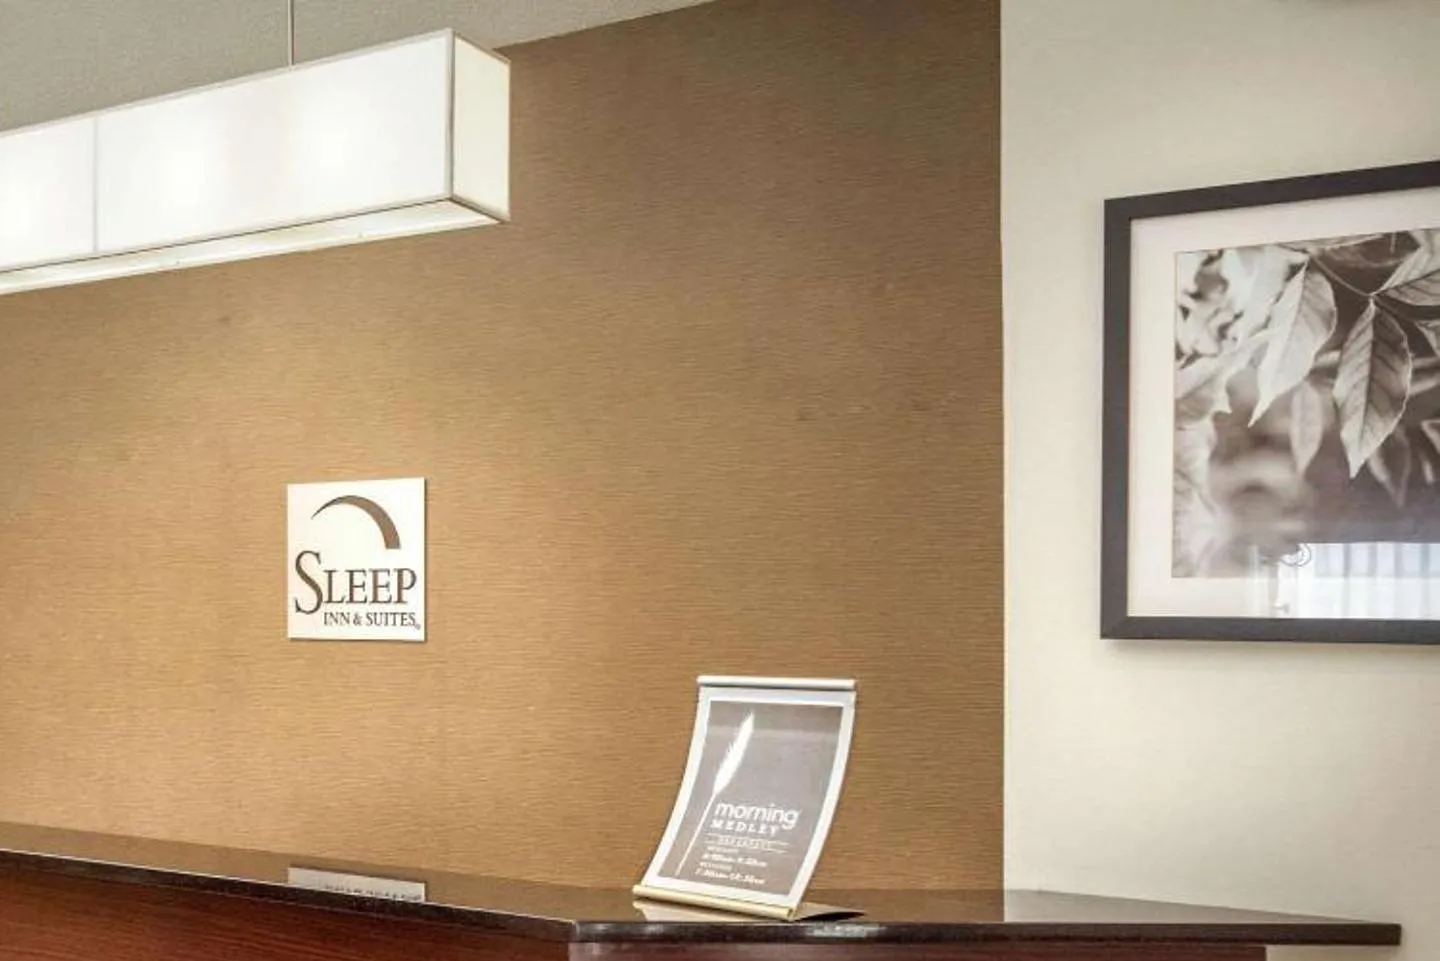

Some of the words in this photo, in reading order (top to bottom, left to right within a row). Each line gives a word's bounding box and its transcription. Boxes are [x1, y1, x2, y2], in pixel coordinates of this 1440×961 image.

[294, 550, 417, 615] SLEEP
[324, 612, 351, 626] INN
[353, 612, 362, 626] &
[711, 819, 779, 836] MEDLEY
[715, 803, 800, 830] morning
